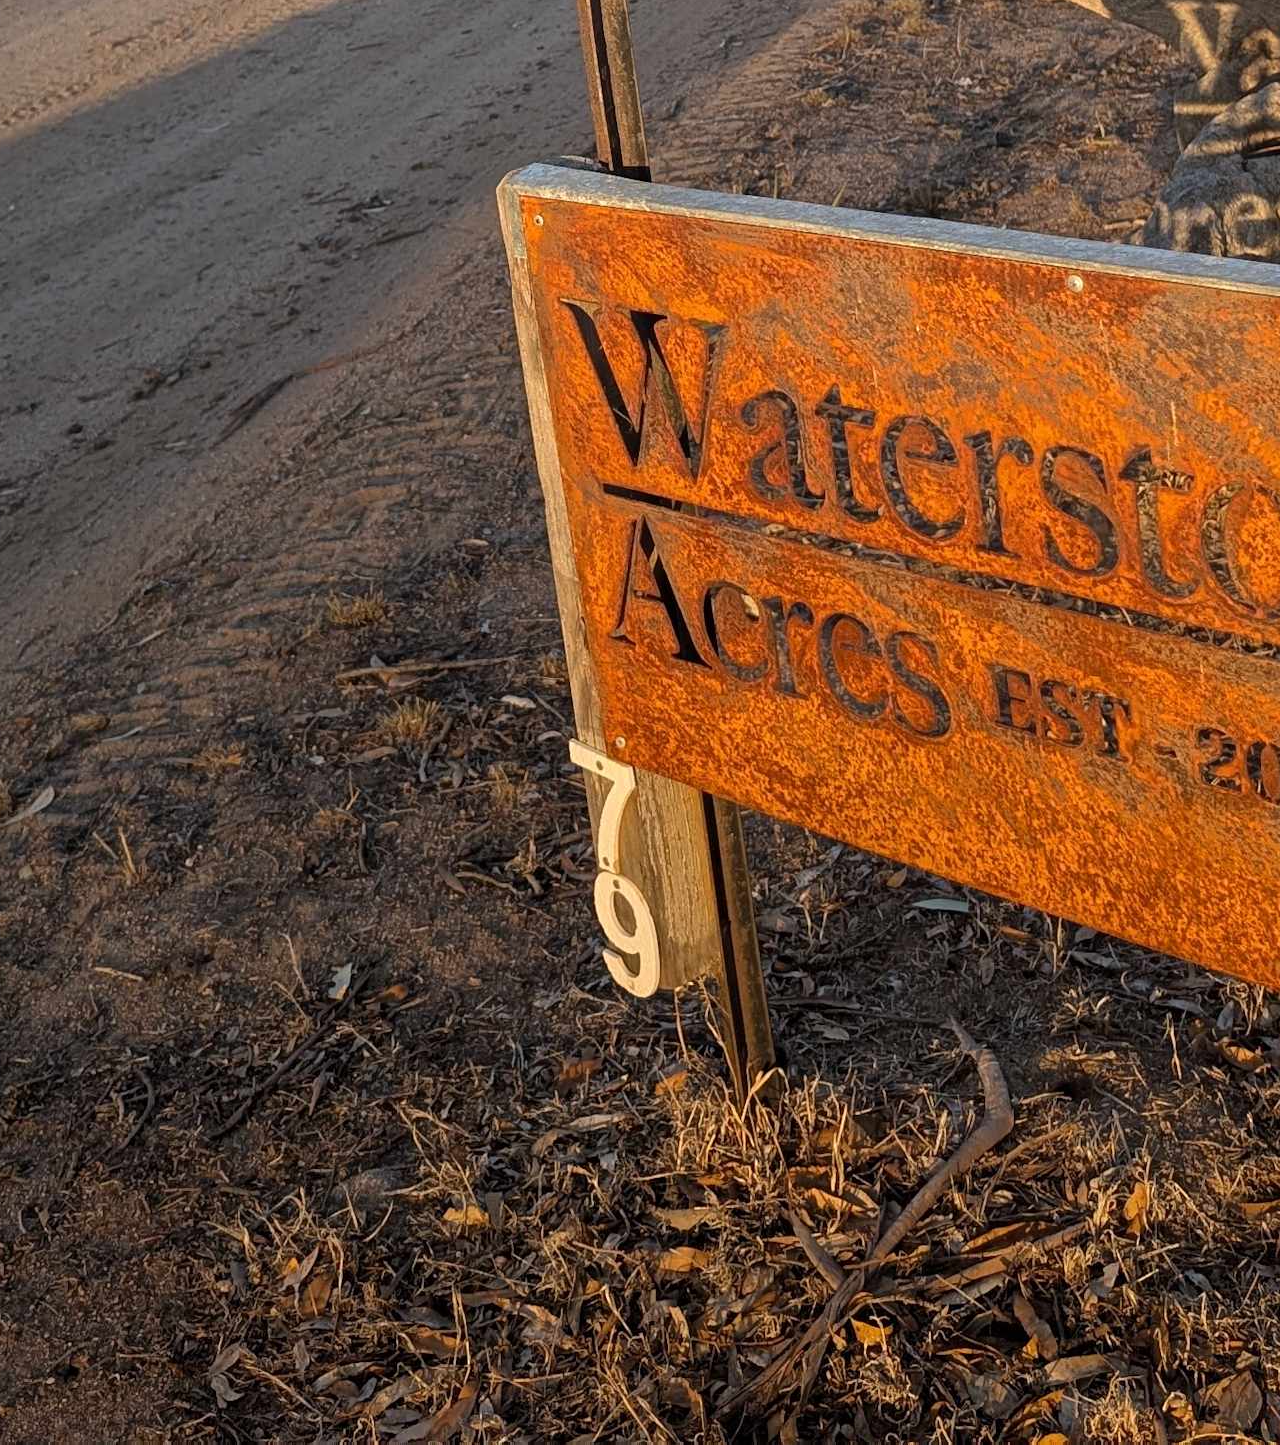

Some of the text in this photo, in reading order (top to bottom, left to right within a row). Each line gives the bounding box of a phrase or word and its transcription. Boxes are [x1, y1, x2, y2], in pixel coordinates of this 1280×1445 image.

[607, 513, 953, 740] Acres
[988, 663, 1133, 757] EST
[569, 738, 661, 998] 79
